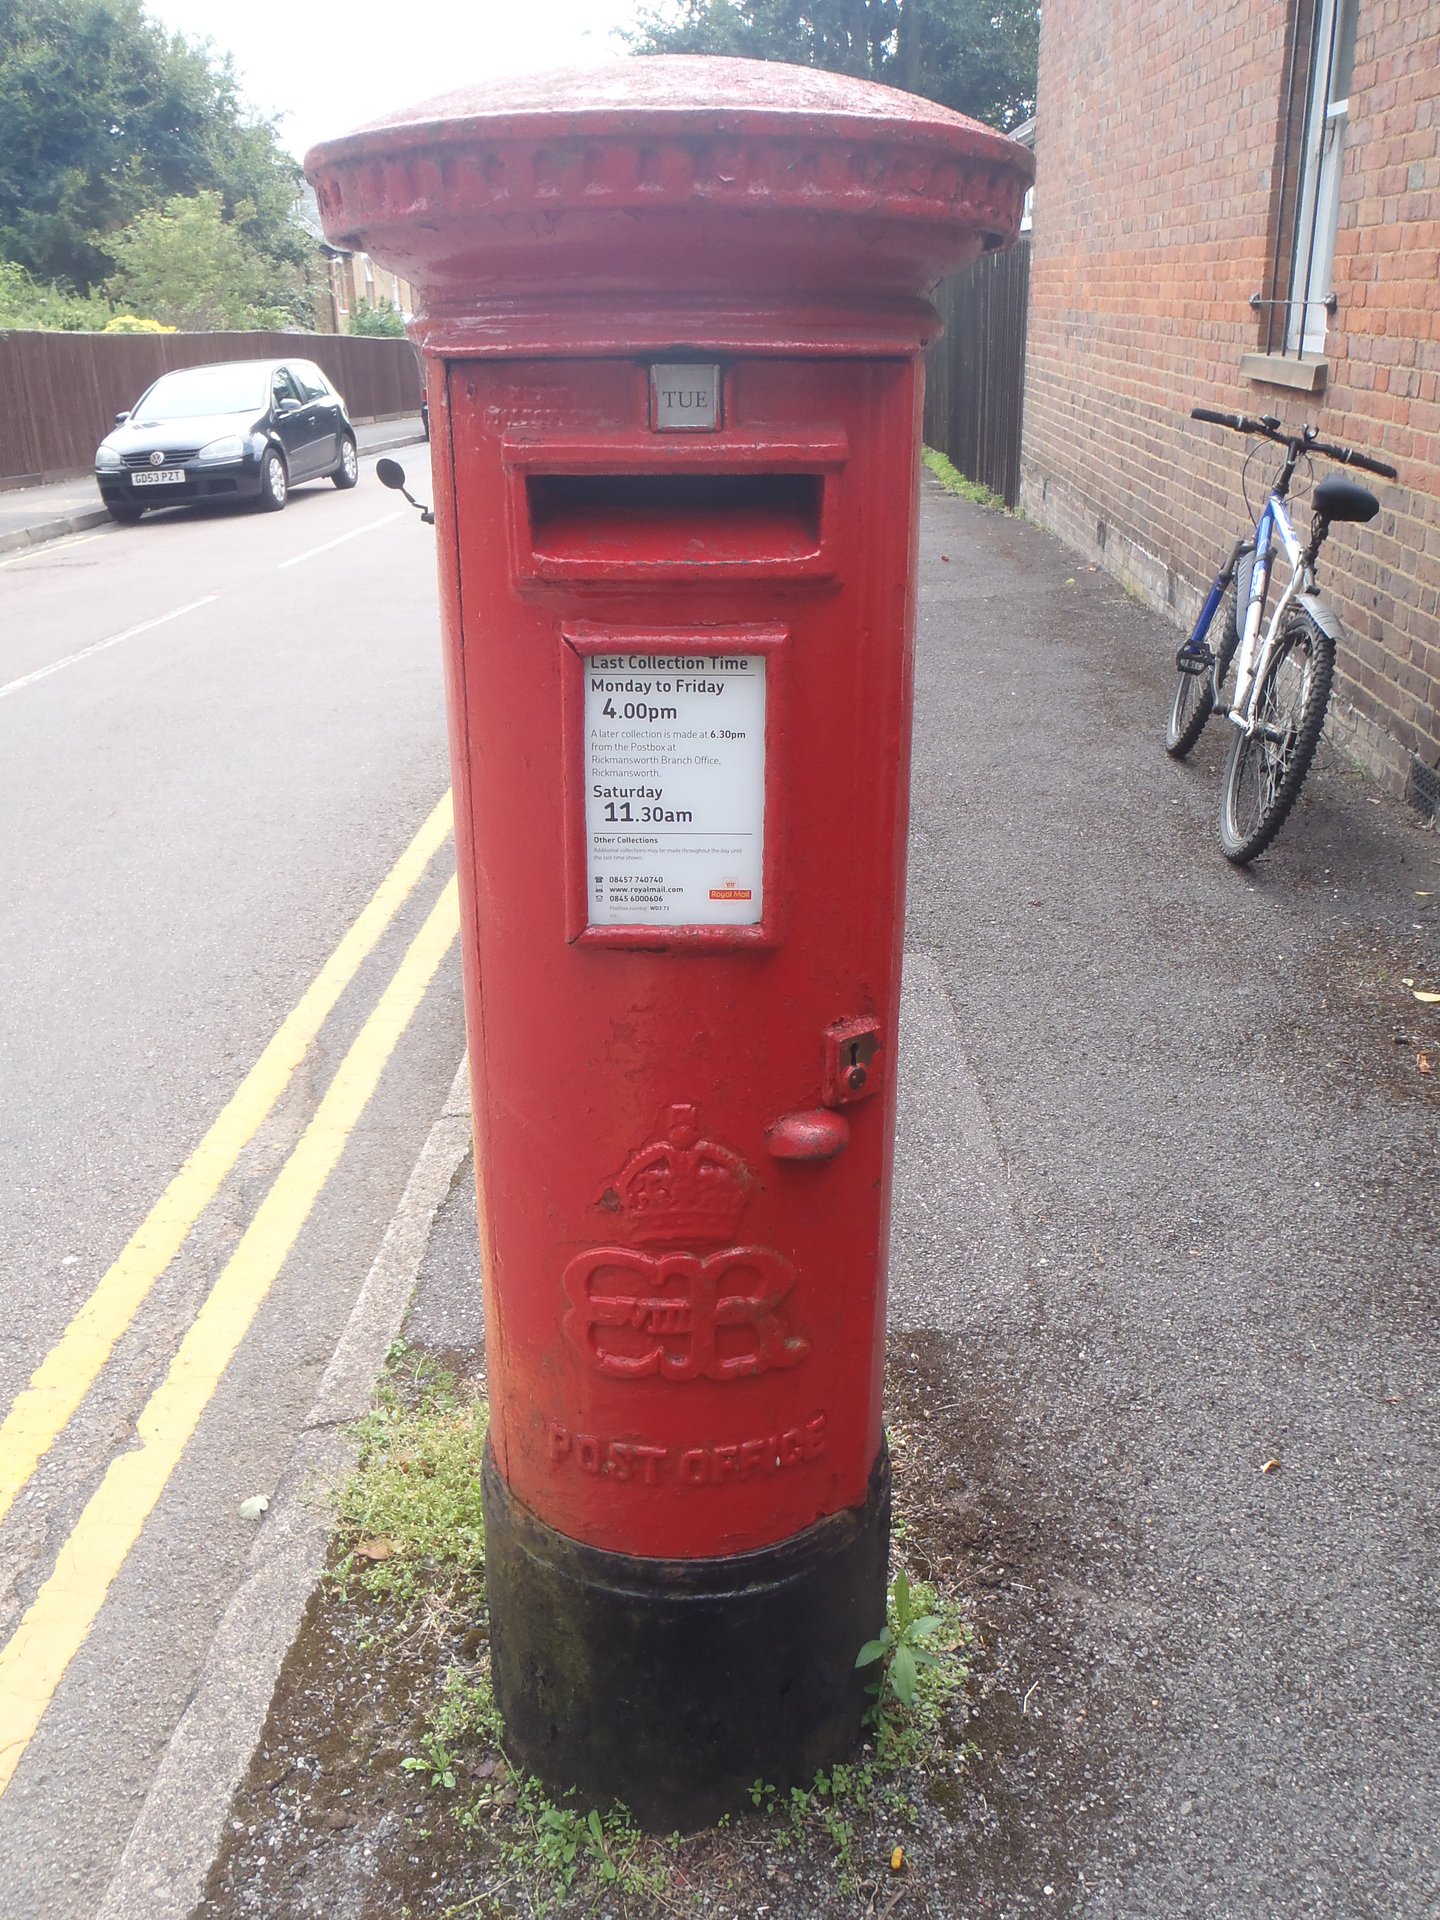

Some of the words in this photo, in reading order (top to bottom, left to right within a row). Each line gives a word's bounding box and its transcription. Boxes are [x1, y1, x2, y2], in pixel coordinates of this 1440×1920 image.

[663, 390, 708, 409] TUE
[135, 473, 159, 484] GD53
[162, 471, 180, 482] PZT
[591, 656, 624, 670] Last
[628, 656, 705, 671] Collection
[709, 656, 749, 670] Time
[591, 679, 652, 695] Monday
[656, 681, 671, 693] to
[676, 680, 725, 696] Friday
[602, 698, 678, 722] 4.00pm
[591, 730, 598, 739] A
[599, 730, 619, 739] later
[622, 730, 662, 739] collection
[664, 731, 671, 739] is
[673, 731, 698, 739] made
[699, 731, 708, 739] at
[710, 730, 746, 740] 6.30pm
[591, 743, 613, 751] from
[615, 743, 629, 752] the
[630, 743, 666, 752] Postbox
[667, 744, 676, 752] at
[591, 756, 659, 765] Rickmansworth
[661, 756, 693, 765] Branch
[695, 756, 721, 766] Office,
[592, 769, 662, 778] Rickmansworth.
[593, 785, 663, 802] Saturday
[604, 802, 693, 823] 11.30am
[594, 836, 615, 844] Other
[617, 836, 659, 844] Collections
[609, 876, 634, 884] 08457
[635, 876, 664, 884] 740740
[609, 885, 684, 894] www.royalmail.com
[711, 890, 732, 899] Royal
[734, 890, 750, 898] Mail
[609, 895, 629, 903] 0845
[630, 895, 664, 903] 6000606
[549, 1418, 667, 1485] POST
[682, 1409, 826, 1484] OFFICE
